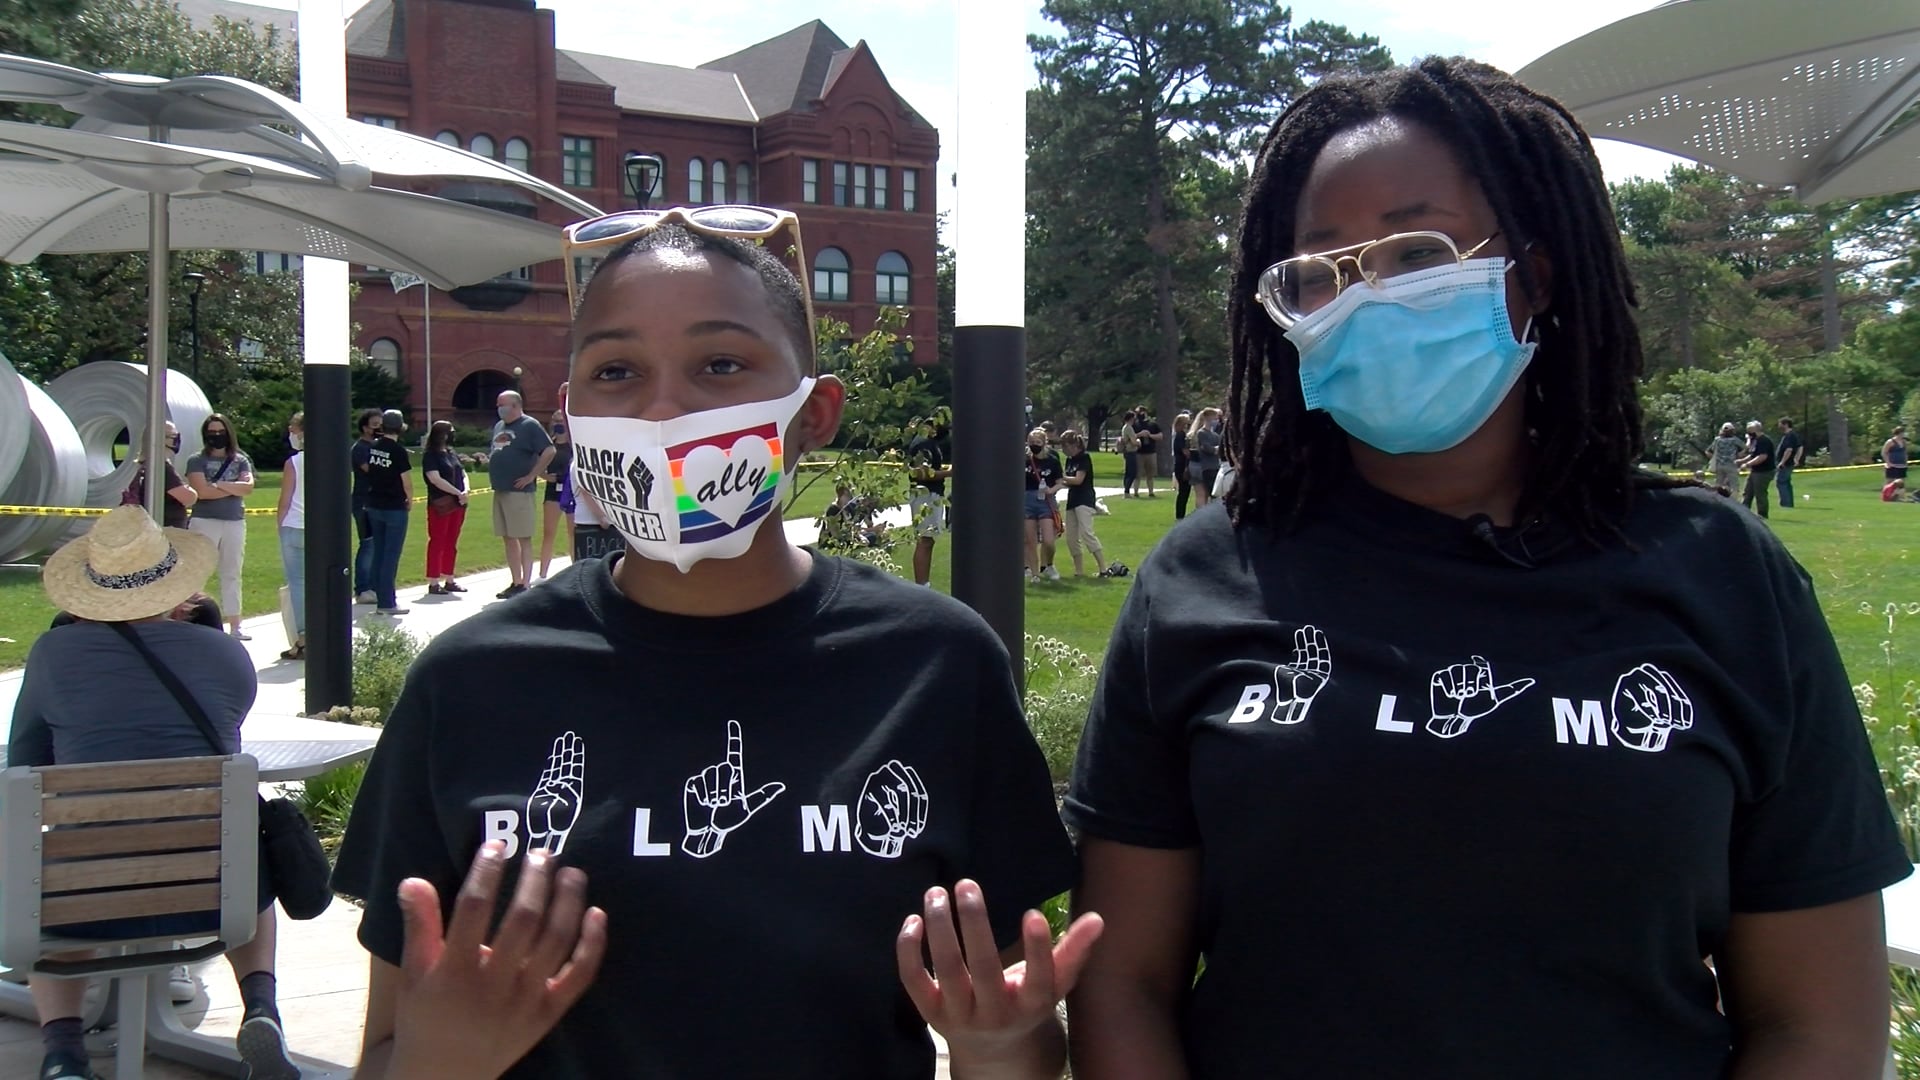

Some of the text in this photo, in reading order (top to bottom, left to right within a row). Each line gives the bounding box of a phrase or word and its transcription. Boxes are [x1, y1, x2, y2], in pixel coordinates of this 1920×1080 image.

[576, 443, 625, 479] BLACK
[696, 458, 767, 504] ally
[577, 470, 628, 506] LIVES
[1228, 684, 1609, 746] B L M
[485, 805, 852, 859] B L M
